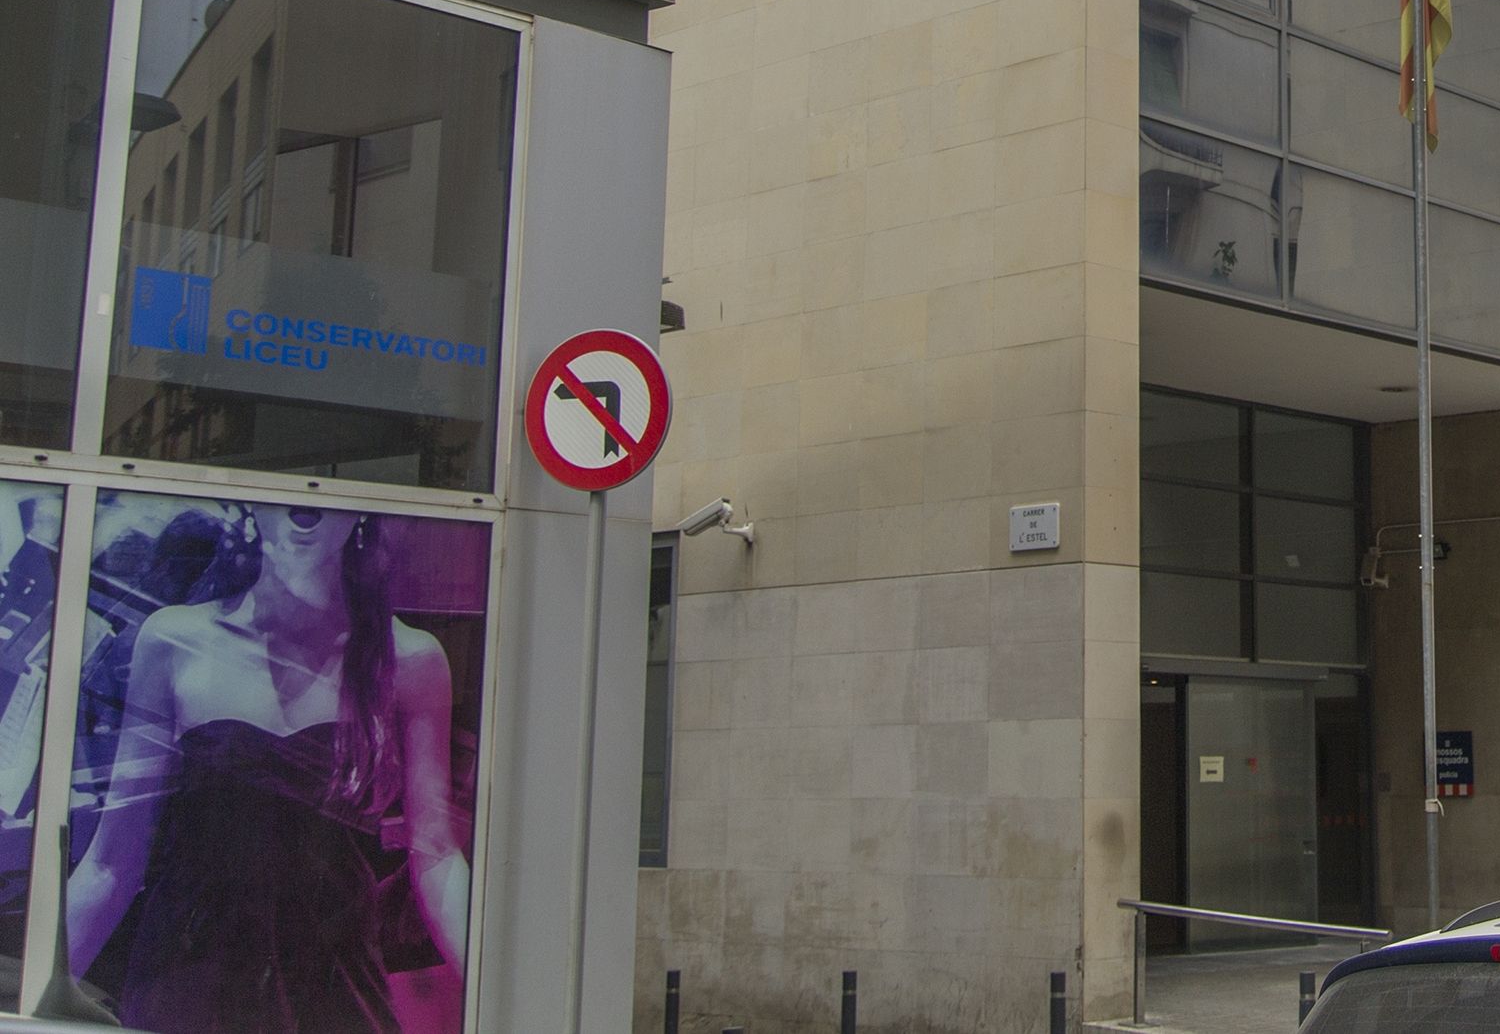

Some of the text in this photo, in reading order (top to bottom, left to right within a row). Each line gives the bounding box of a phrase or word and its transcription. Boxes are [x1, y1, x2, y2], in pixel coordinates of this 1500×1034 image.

[225, 309, 487, 366] CONSERVATORI
[224, 337, 330, 371] LICEU
[1022, 508, 1045, 517] CARRER
[1018, 532, 1048, 543] L'ESTEL
